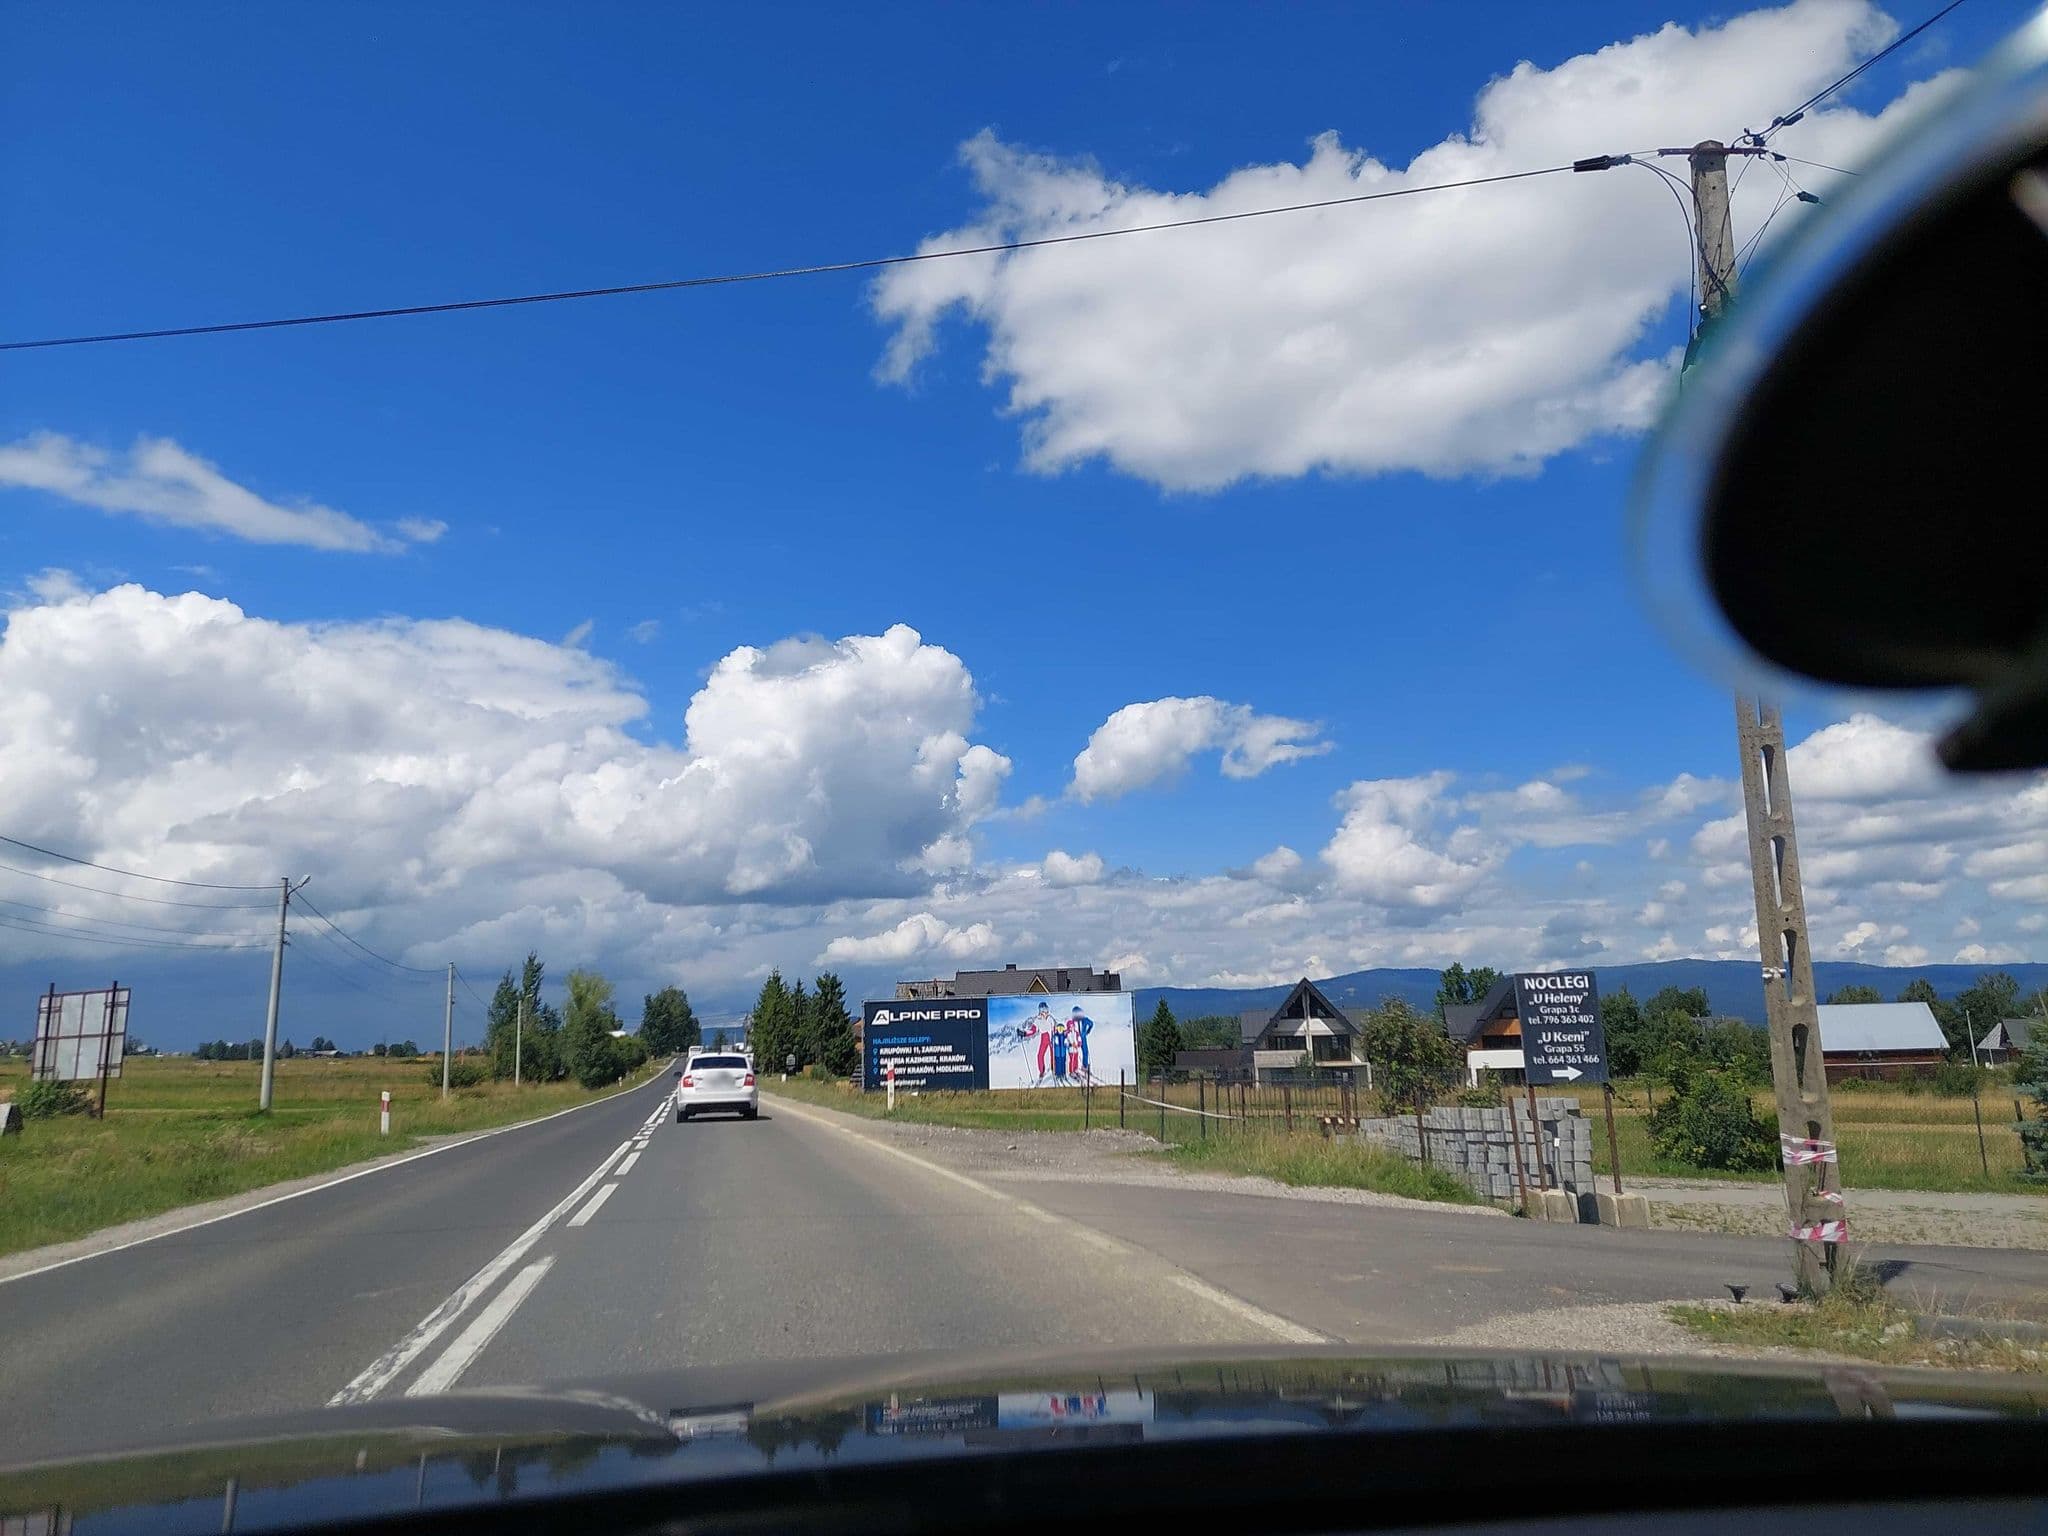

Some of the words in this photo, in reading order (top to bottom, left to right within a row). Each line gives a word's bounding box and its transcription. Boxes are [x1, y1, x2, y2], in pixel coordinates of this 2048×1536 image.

[1524, 975, 1589, 990] NOCLEGI
[1540, 1006, 1568, 1014] Grapa
[1569, 1005, 1580, 1014] 1c
[872, 1009, 941, 1025] ALPINE
[944, 1009, 981, 1020] PRO
[1528, 1016, 1542, 1024] tel.
[1542, 1016, 1560, 1024] 796
[1560, 1016, 1577, 1024] 363
[1578, 1015, 1594, 1024] 402
[1544, 1045, 1572, 1054] Grapa
[1574, 1044, 1586, 1052] 55
[1533, 1056, 1548, 1064] tel.
[1548, 1056, 1565, 1064] 664
[1566, 1056, 1582, 1064] 361
[1583, 1055, 1600, 1063] 466
